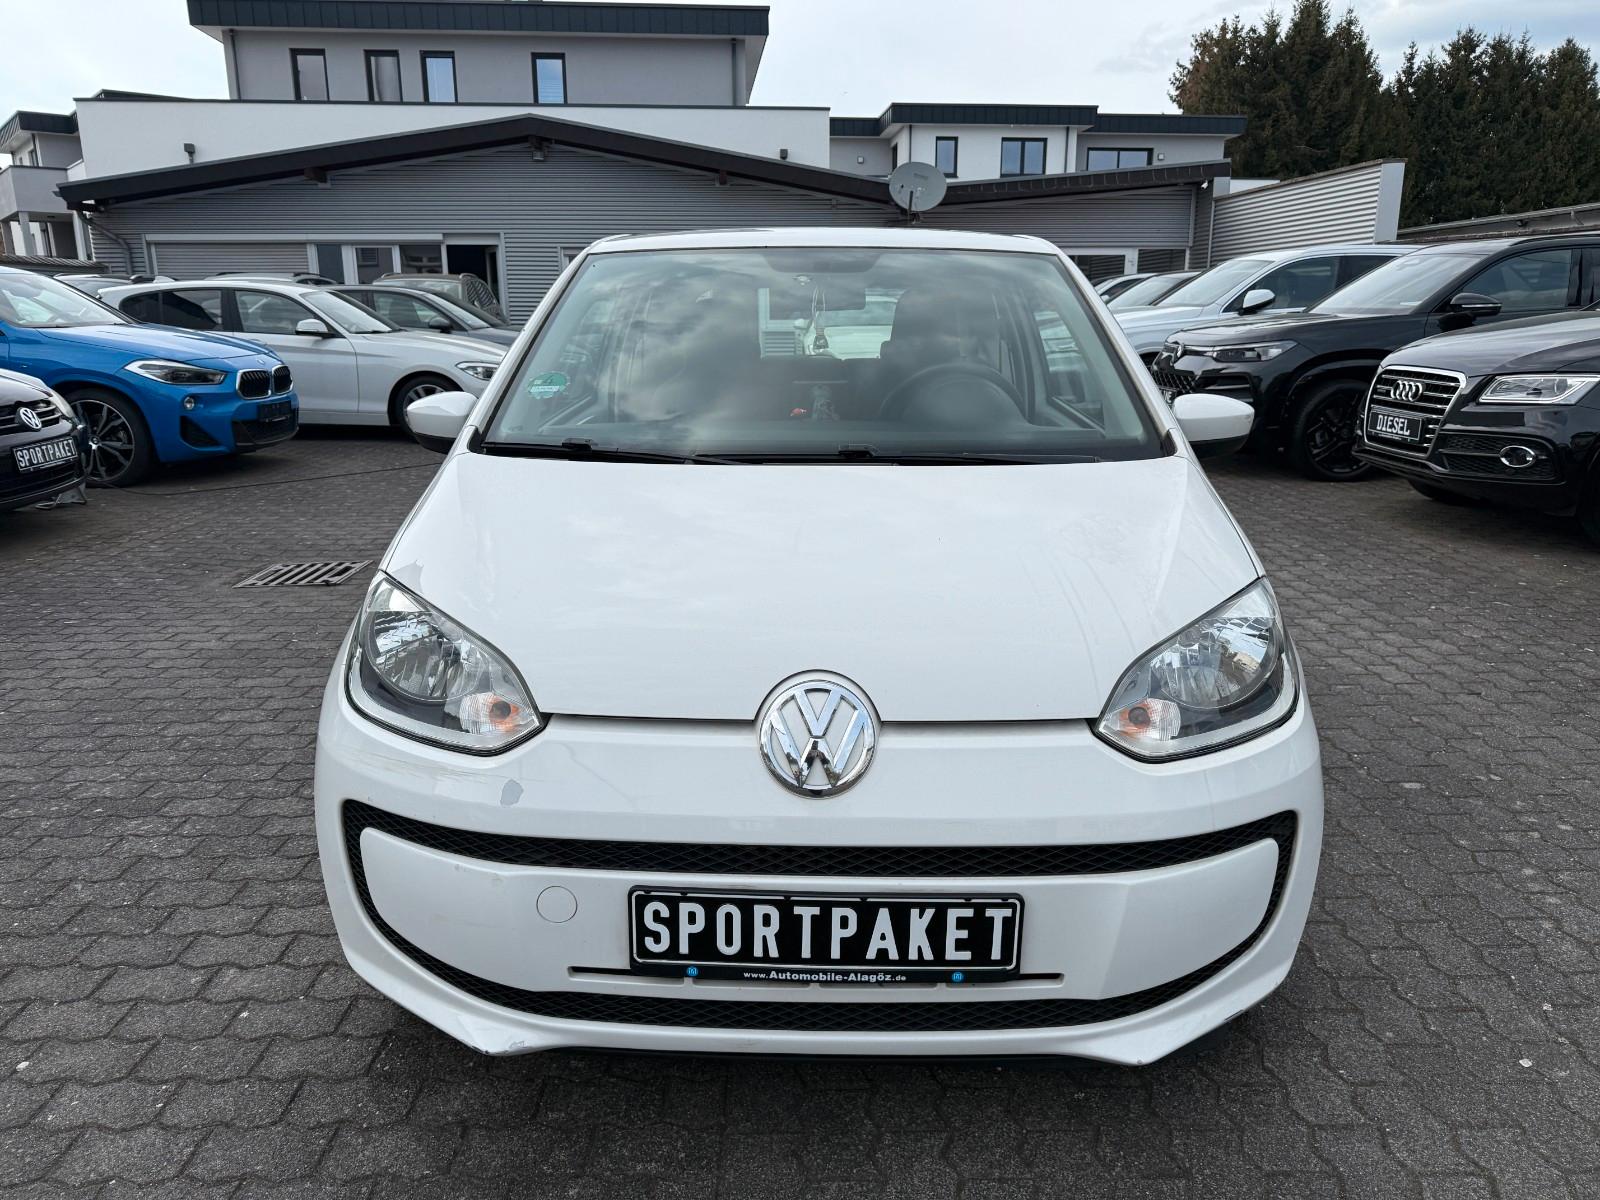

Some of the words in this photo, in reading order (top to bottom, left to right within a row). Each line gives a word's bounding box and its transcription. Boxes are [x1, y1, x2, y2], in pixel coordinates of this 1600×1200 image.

[1376, 414, 1410, 436] DIESEL
[16, 439, 76, 468] SPORTPAKET
[643, 900, 1012, 961] SPORTPAKET
[743, 970, 907, 983] www.Automobile-Alagöz.de
